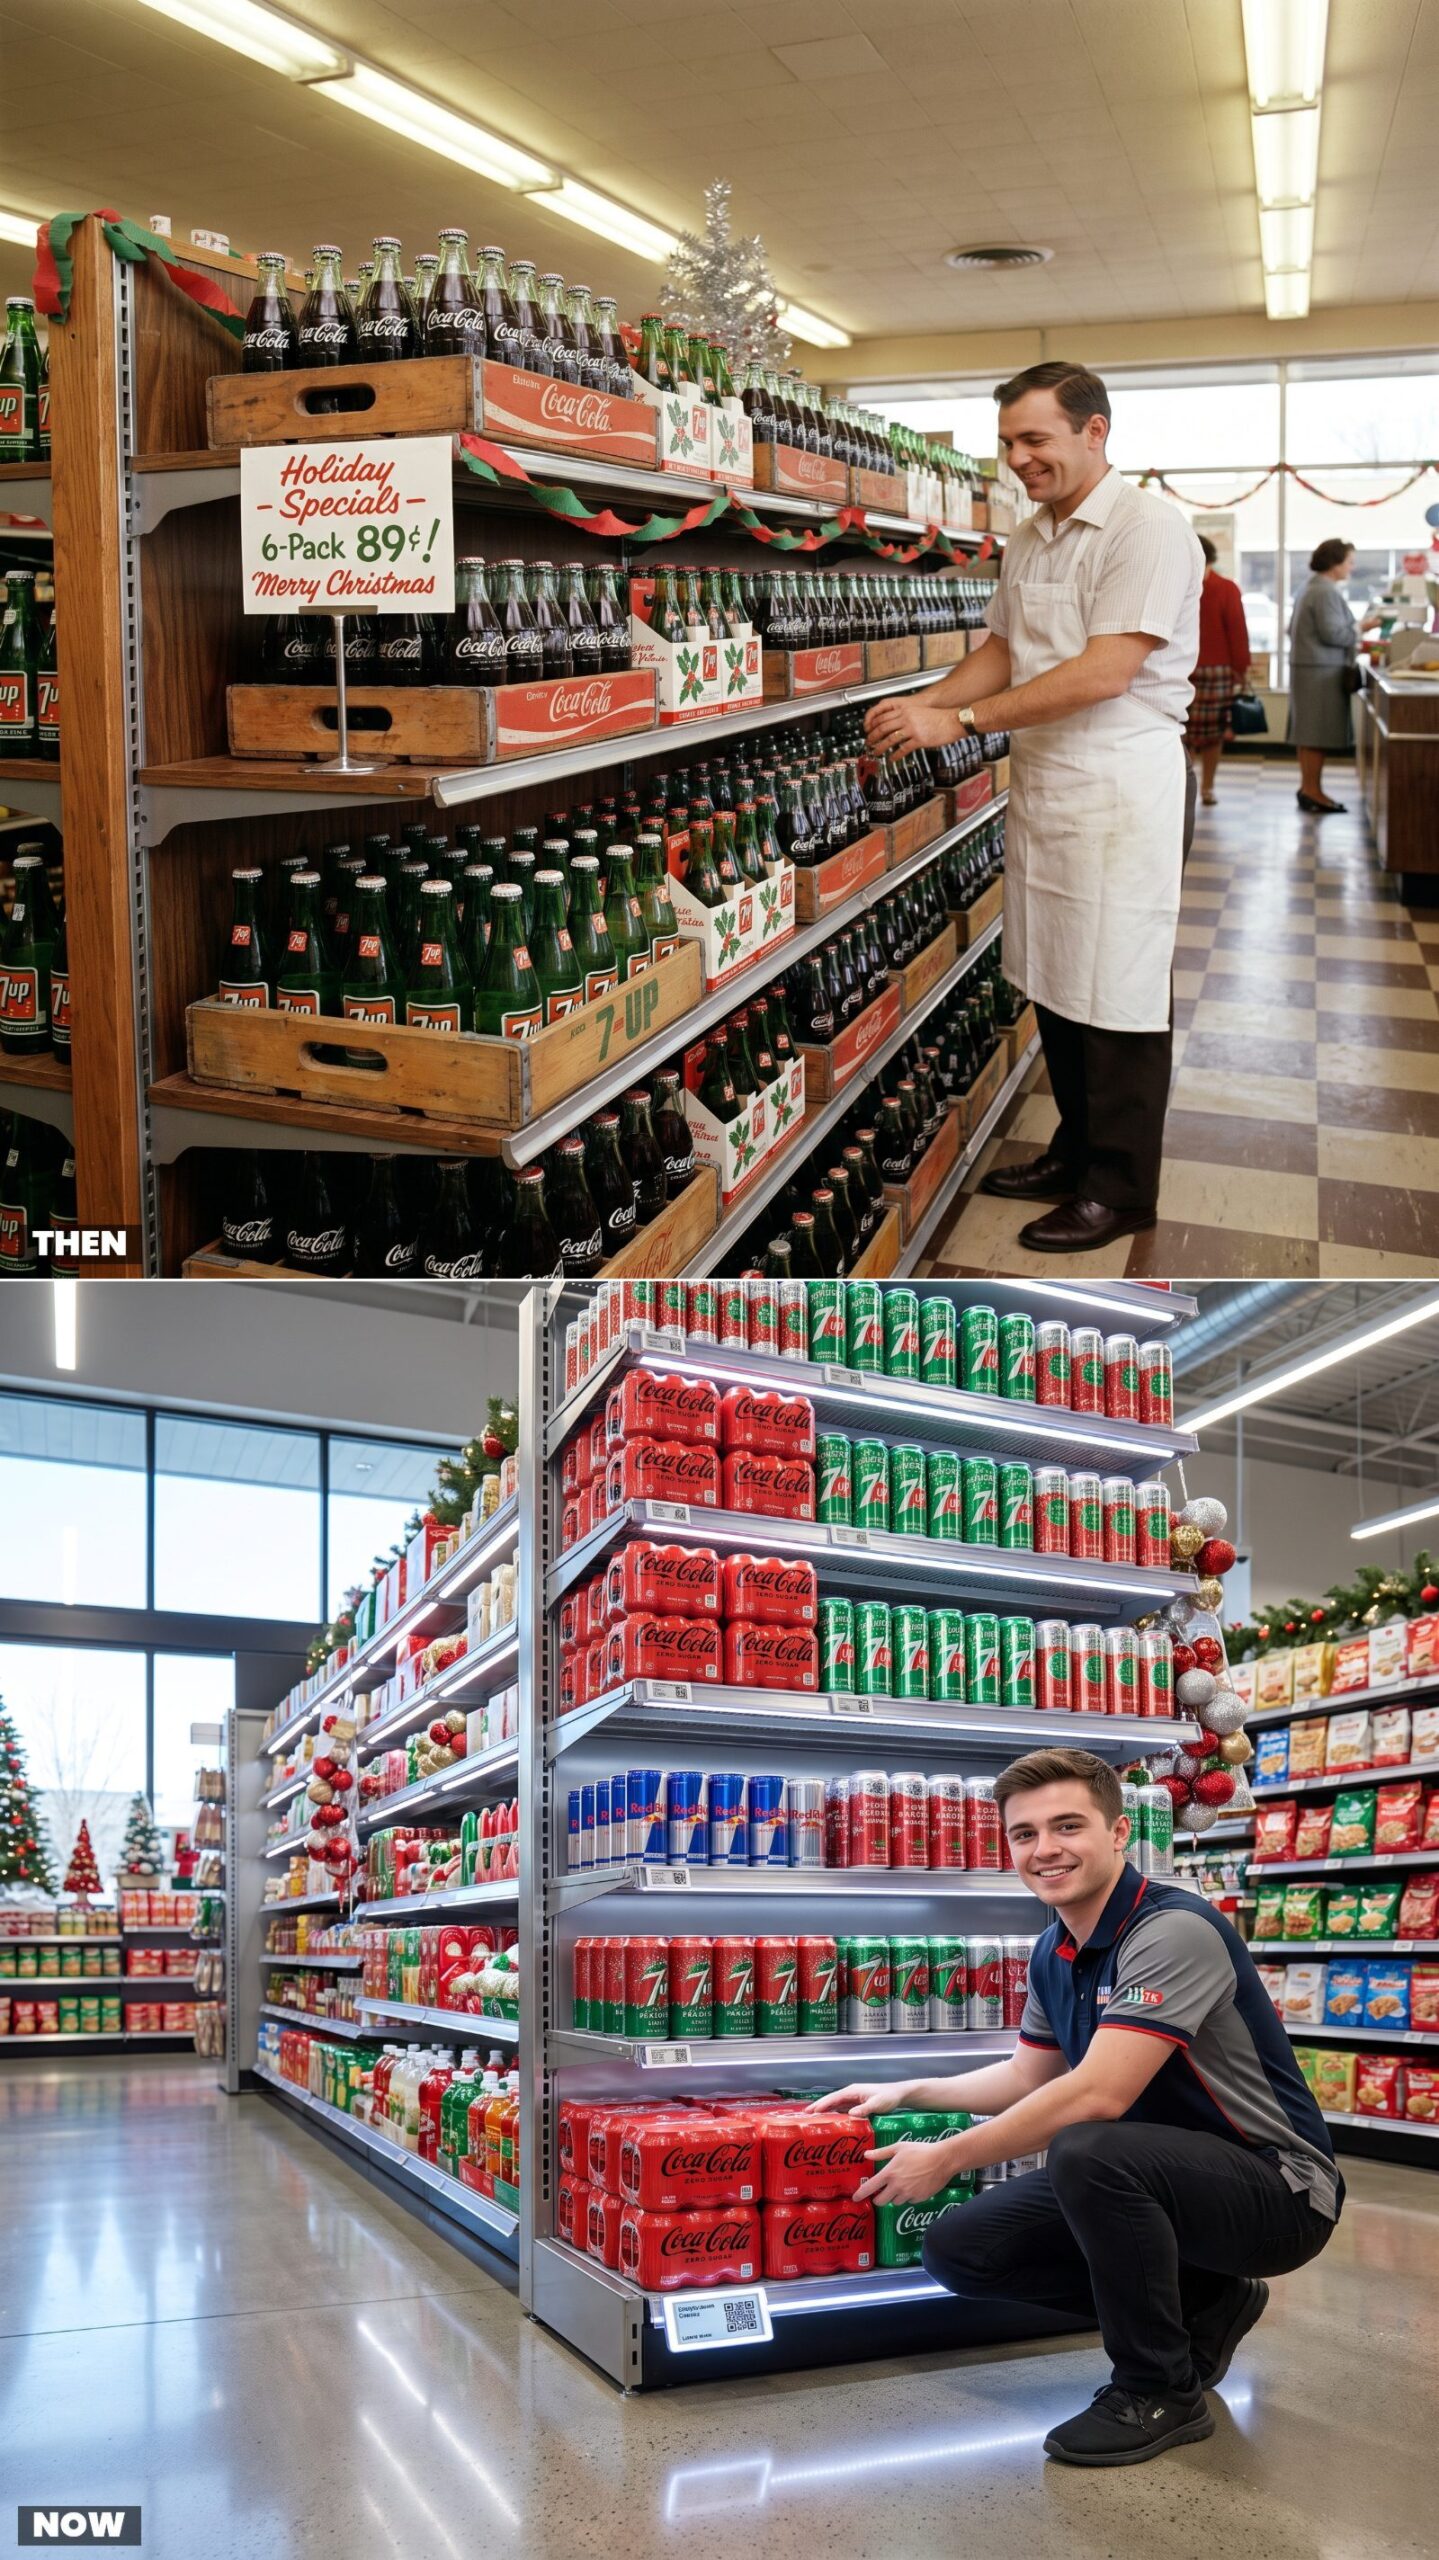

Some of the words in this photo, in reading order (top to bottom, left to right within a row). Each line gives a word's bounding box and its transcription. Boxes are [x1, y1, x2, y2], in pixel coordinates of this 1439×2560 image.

[427, 308, 485, 330] Coca-Cola
[540, 383, 613, 432] Coca-Cola
[280, 453, 395, 490] Holiday
[279, 486, 400, 526] Specials
[261, 532, 346, 561] 6-Pack
[252, 571, 321, 603] Merry
[326, 570, 436, 596] Christmas
[550, 681, 613, 722] Coca-Cola
[287, 1225, 346, 1254] Coca-Cola
[637, 1379, 716, 1413] Coca-Cola
[735, 1397, 812, 1430] Coca-Cola
[635, 1446, 716, 1480] Coca-Cola
[735, 1461, 811, 1493] Coca-Cola
[635, 1551, 716, 1583] Coca-Cola
[736, 1564, 813, 1595] Coca-Cola
[635, 1622, 717, 1653] Coca-Cola
[737, 1631, 814, 1662] Coca-Cola
[631, 1803, 653, 1814] Red
[674, 1804, 695, 1815] Red
[715, 1806, 736, 1816] Red
[755, 1807, 776, 1817] Red
[661, 2143, 754, 2177] Coca-Cola
[784, 2135, 872, 2169] Coca-Cola
[708, 2175, 733, 2183] SUGAR
[829, 2167, 850, 2175] SUGAR
[661, 2221, 754, 2256] Coca-Cola
[784, 2212, 871, 2247] Coca-Cola
[684, 2256, 705, 2264] ZERO
[709, 2254, 732, 2262] SUGAR
